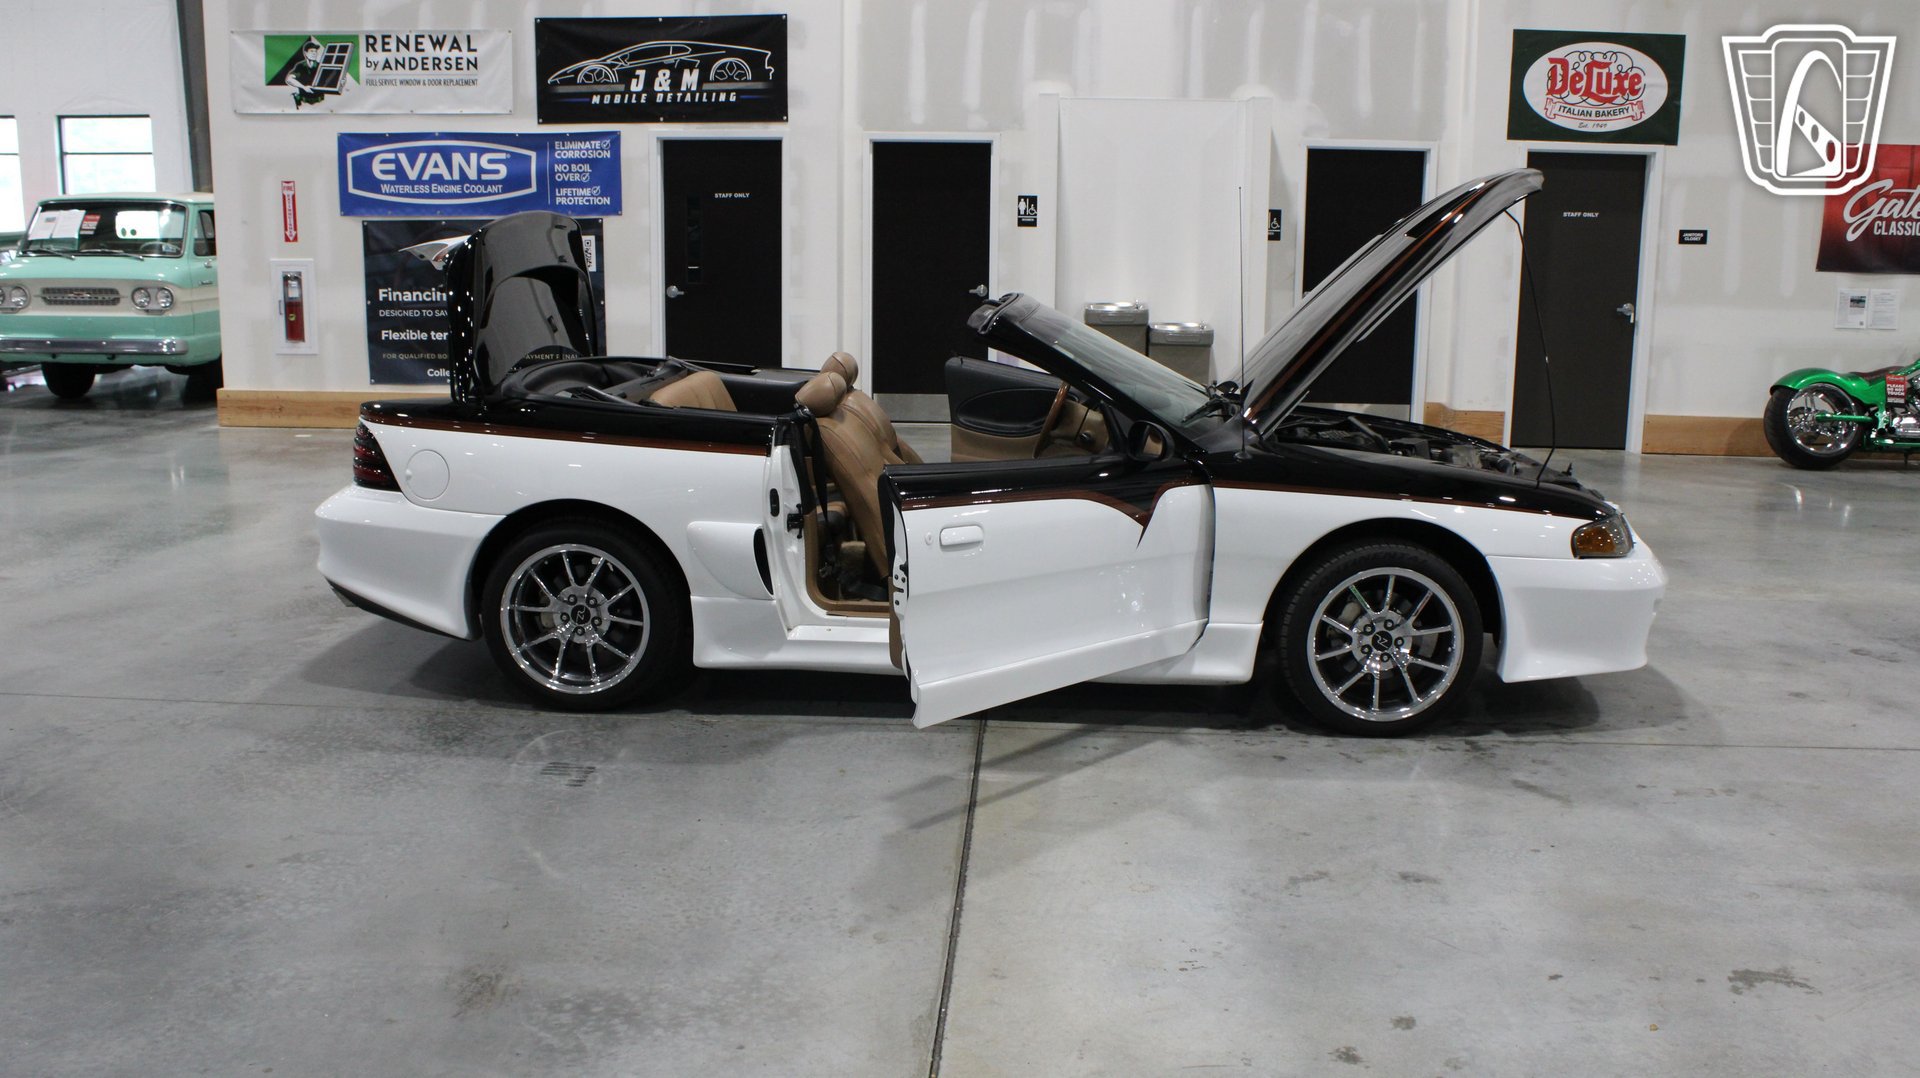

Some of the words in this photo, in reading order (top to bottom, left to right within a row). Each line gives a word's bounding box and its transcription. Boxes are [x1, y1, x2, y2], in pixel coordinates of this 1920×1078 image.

[365, 34, 478, 53] RENEWAL
[365, 57, 379, 71] by
[381, 56, 478, 71] ANDERSEN
[399, 79, 421, 87] WINDOW
[427, 79, 442, 87] DOOR
[443, 79, 478, 87] REPLACEMENT
[630, 69, 647, 93] J
[653, 68, 672, 92] &
[680, 68, 700, 92] M
[1546, 57, 1643, 104] DeLuxe
[591, 93, 648, 105] MOBILE
[655, 92, 738, 103] DETAILING
[1558, 106, 1593, 118] ITALIAN
[1594, 106, 1631, 118] BAKERY
[554, 141, 601, 150] ELIMINATE
[554, 150, 611, 159] CORROSION
[371, 152, 508, 181] EVANS
[554, 164, 569, 172] NO
[571, 164, 592, 172] BOIL
[555, 173, 581, 182] OVER
[555, 188, 592, 196] LIFETIME
[555, 196, 611, 205] PROTECTION
[378, 309, 421, 317] DESIGNED
[422, 309, 433, 317] TO
[381, 329, 428, 341] Flexible
[398, 353, 437, 361] QUALIFIED
